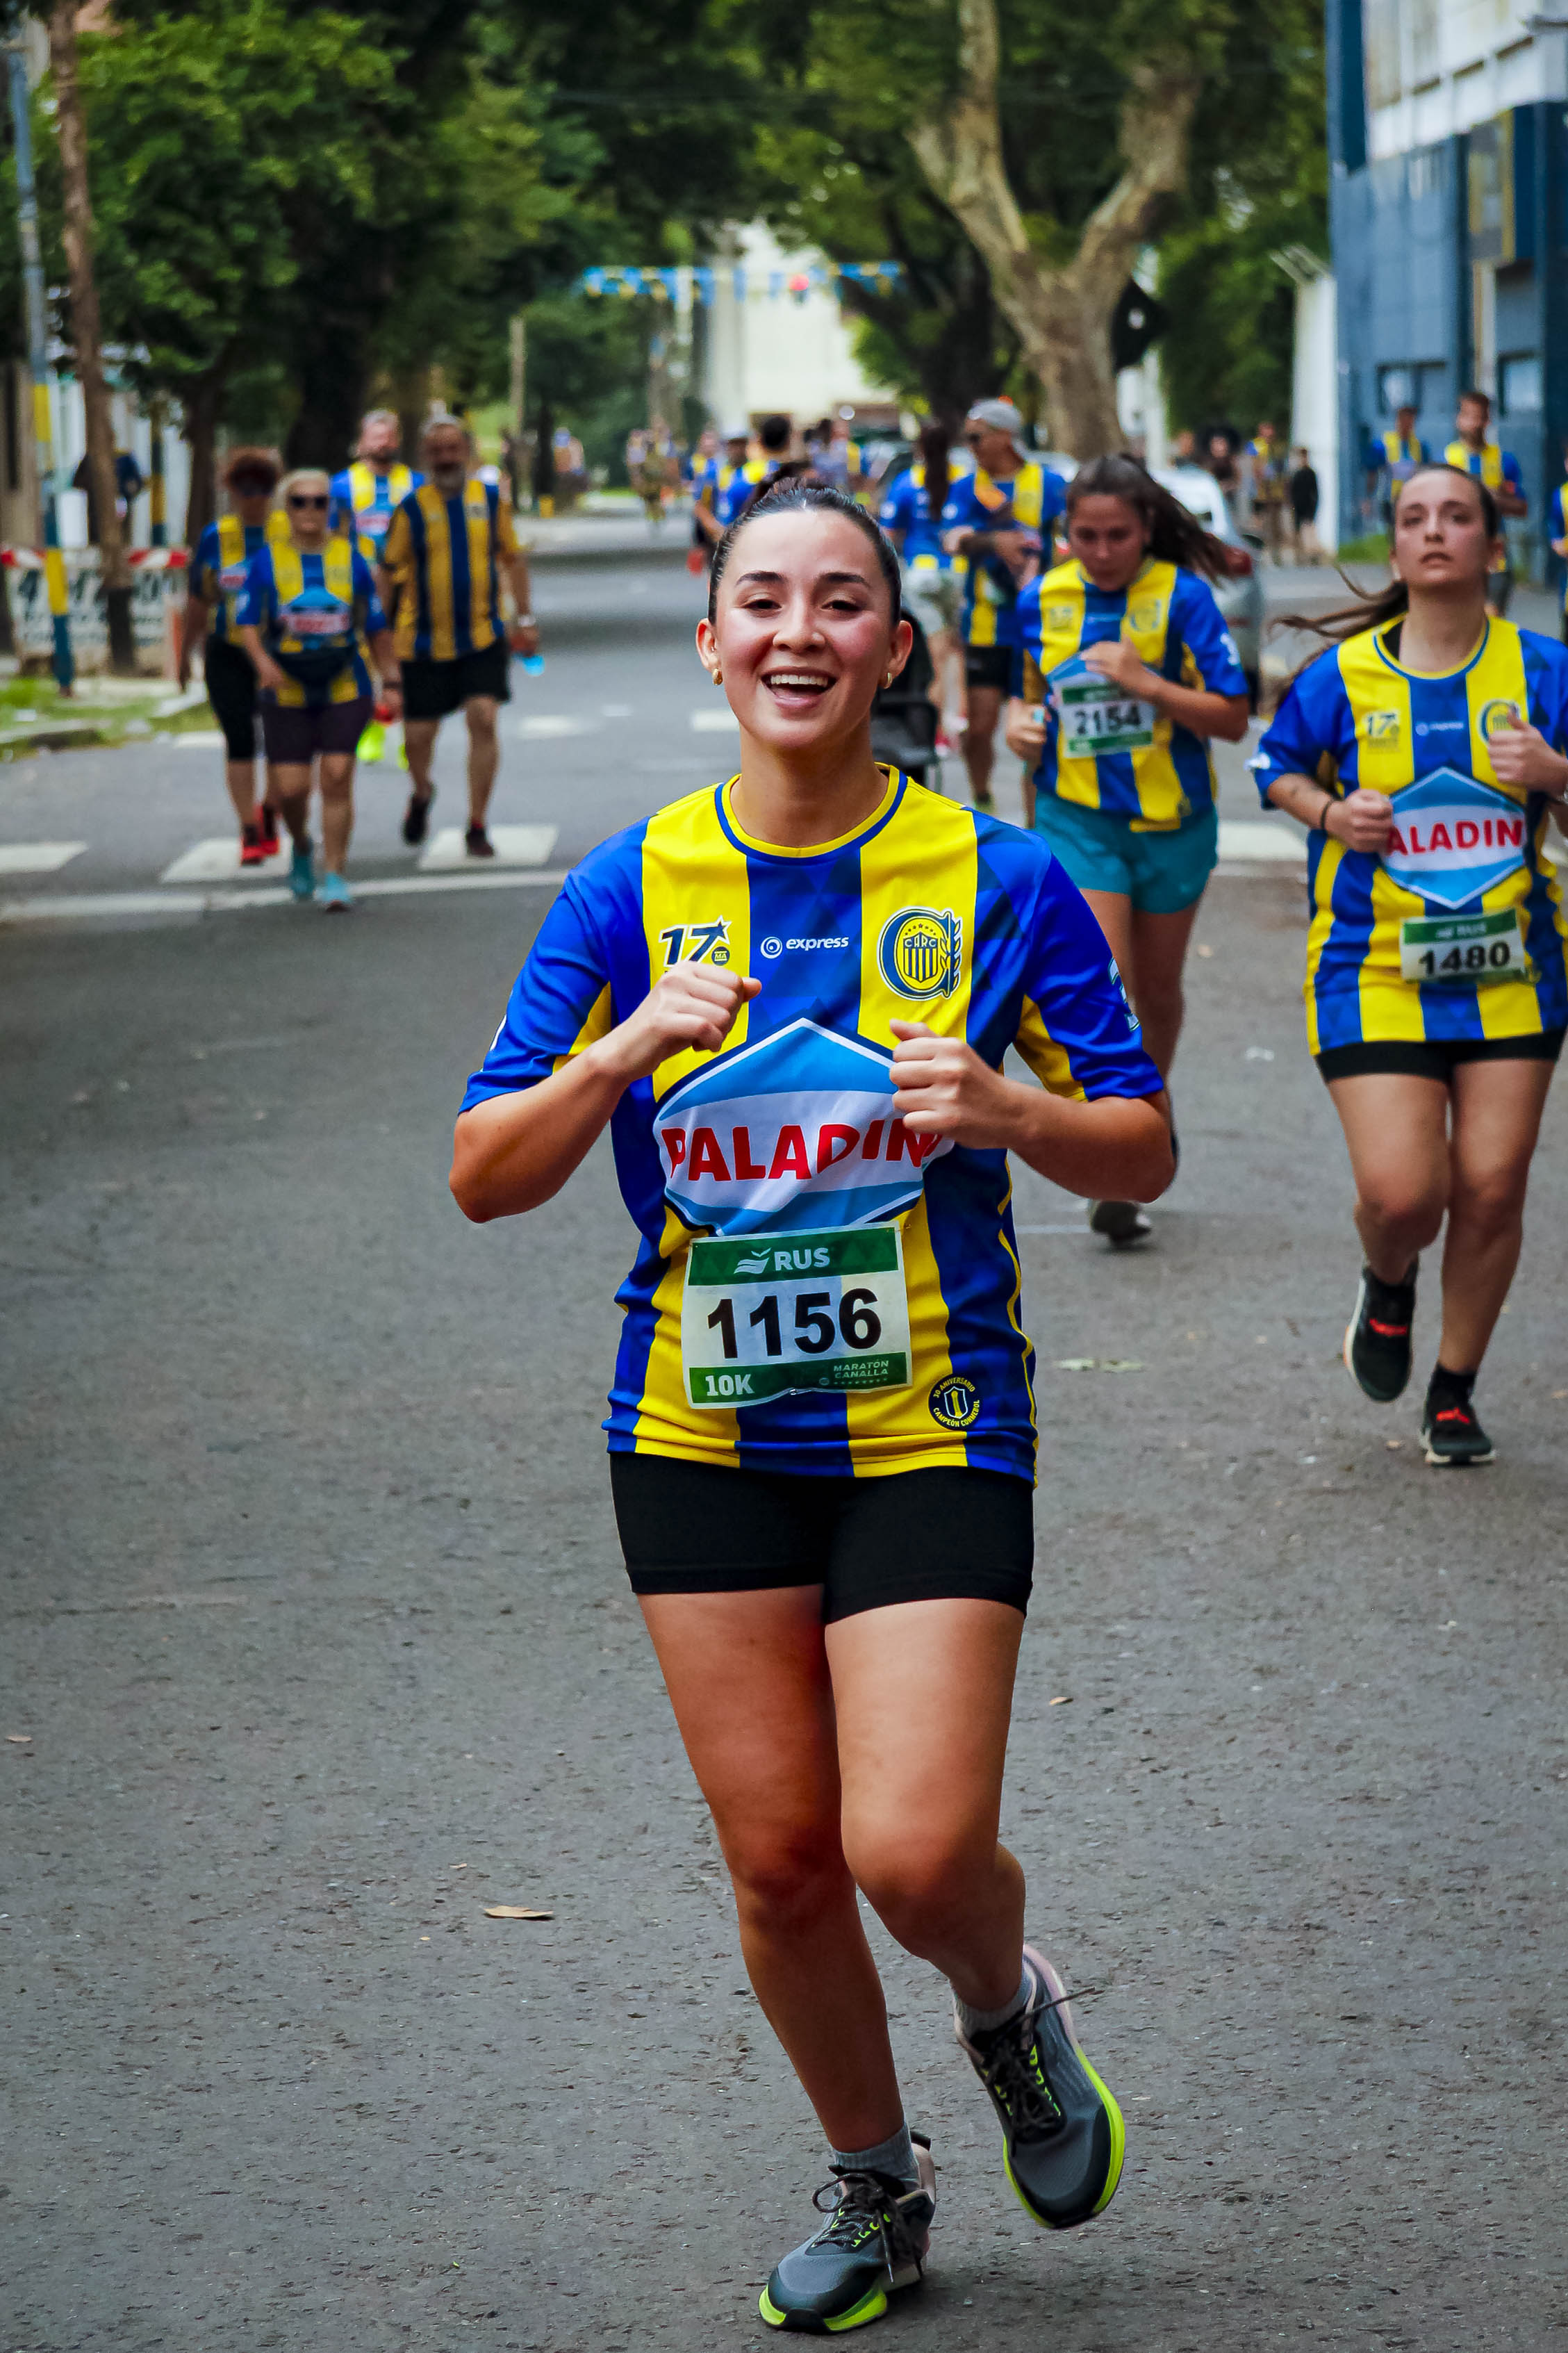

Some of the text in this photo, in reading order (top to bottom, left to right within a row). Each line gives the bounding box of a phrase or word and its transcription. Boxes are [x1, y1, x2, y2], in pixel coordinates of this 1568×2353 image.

[1385, 819, 1524, 856] ALADIN
[661, 919, 727, 966] 17
[786, 935, 849, 951] express
[905, 934, 936, 947] CARC
[1418, 941, 1510, 974] 1480
[661, 1118, 943, 1181] PALADIN
[774, 1247, 830, 1271] RUS
[707, 1288, 882, 1359] 1156
[706, 1374, 754, 1397] 10K
[834, 1368, 889, 1379] CANALLA
[933, 1377, 975, 1398] 30 ANIVERSARIO
[961, 1400, 980, 1426] CONMEBOL
